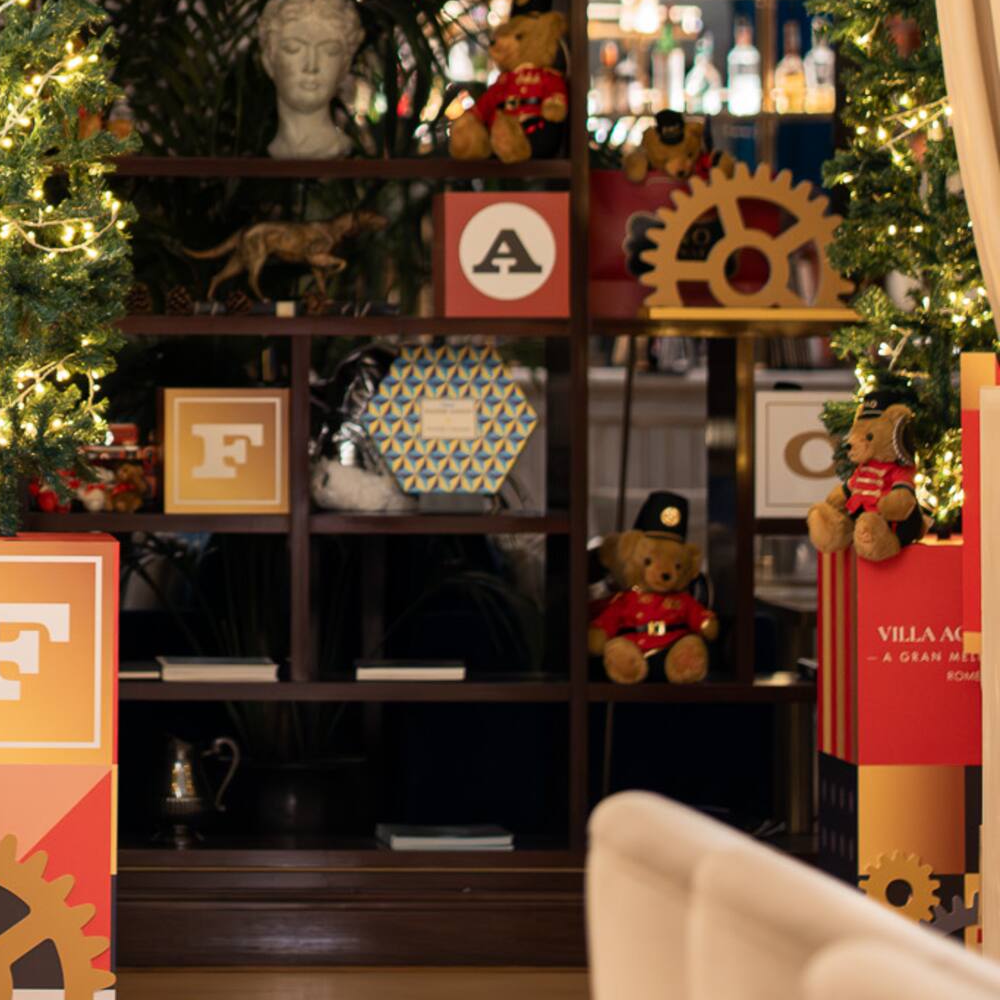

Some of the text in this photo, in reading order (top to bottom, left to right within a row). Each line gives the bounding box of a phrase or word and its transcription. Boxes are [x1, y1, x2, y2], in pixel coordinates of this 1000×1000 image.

[472, 229, 543, 273] A
[191, 423, 264, 478] F
[878, 625, 936, 643] VILLA
[882, 651, 893, 663] A
[899, 651, 942, 663] GRAN
